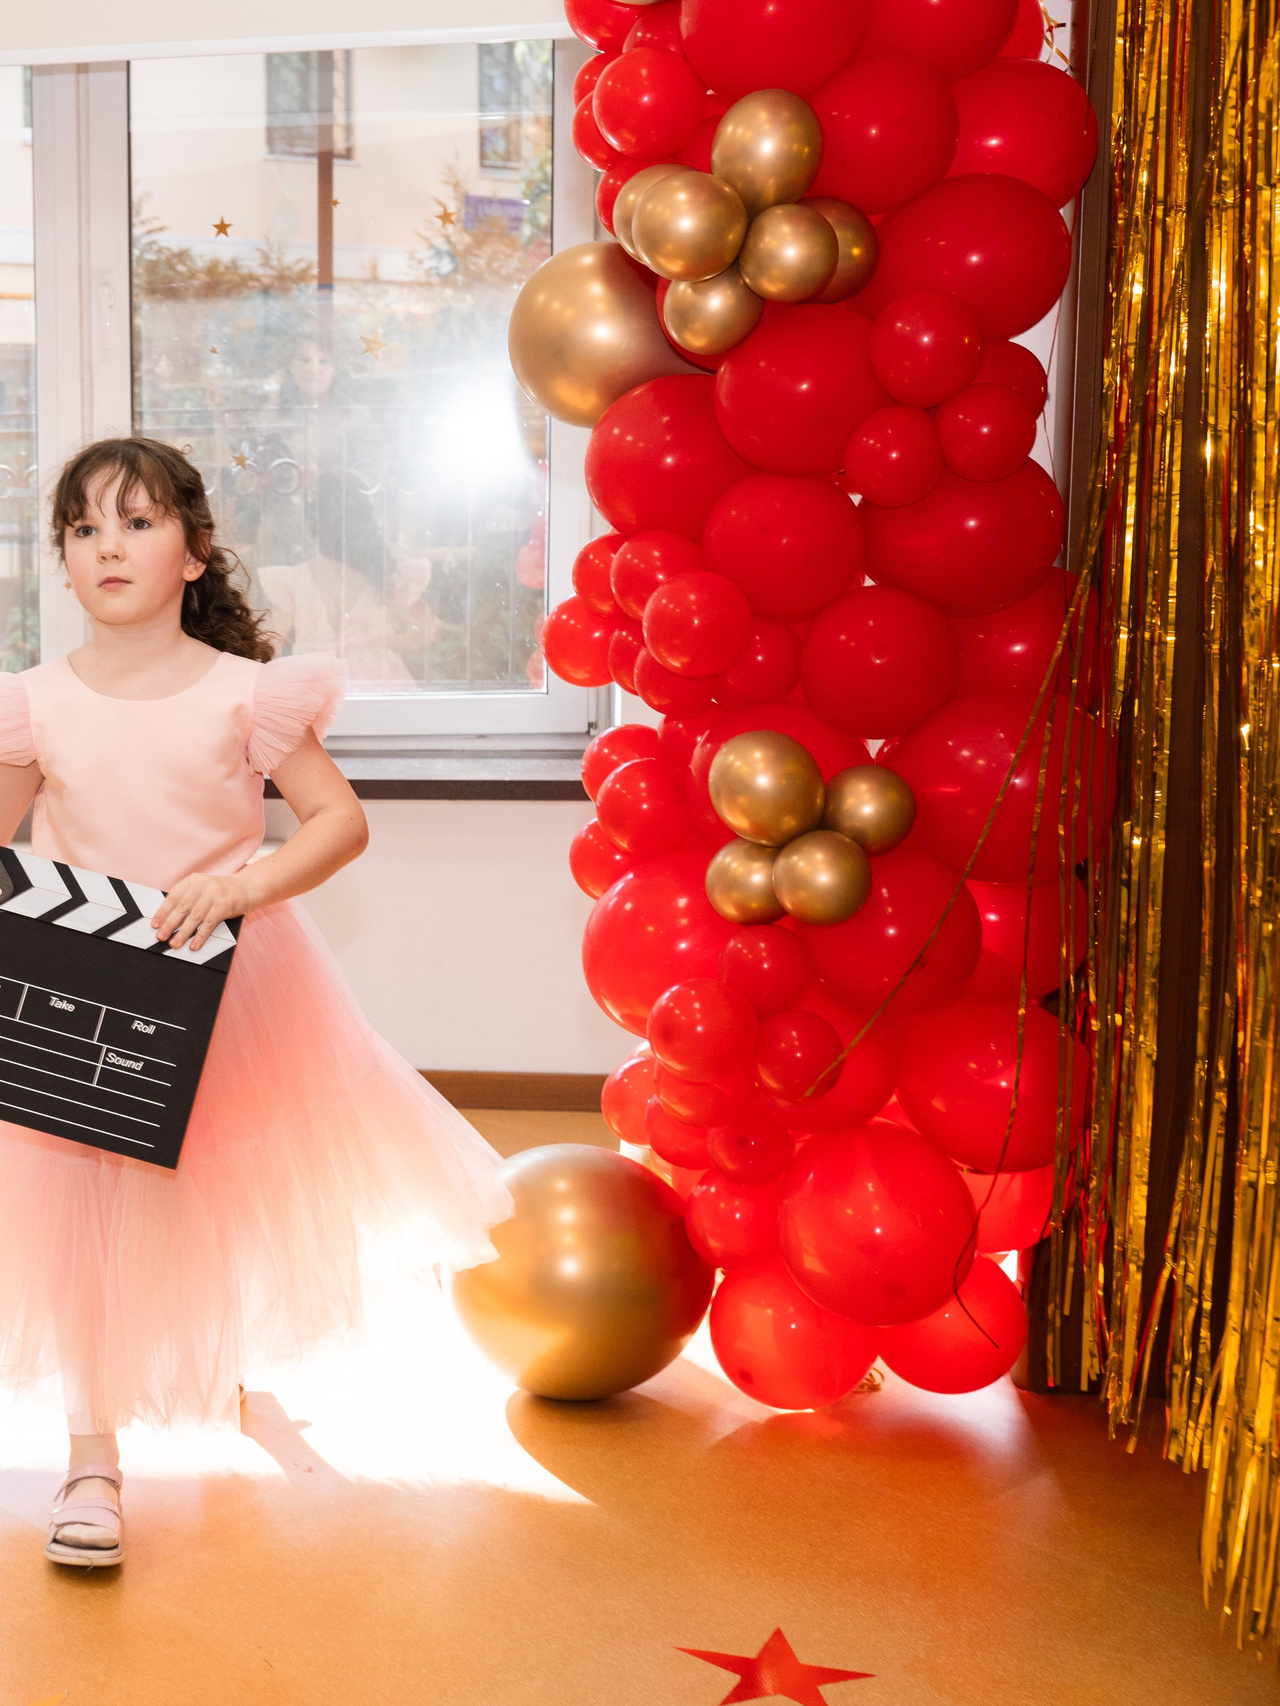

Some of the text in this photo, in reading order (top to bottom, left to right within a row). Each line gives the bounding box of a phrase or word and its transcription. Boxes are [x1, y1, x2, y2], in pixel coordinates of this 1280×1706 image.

[49, 997, 76, 1012] Take
[131, 1021, 156, 1035] Roll
[106, 1052, 144, 1071] Sound
